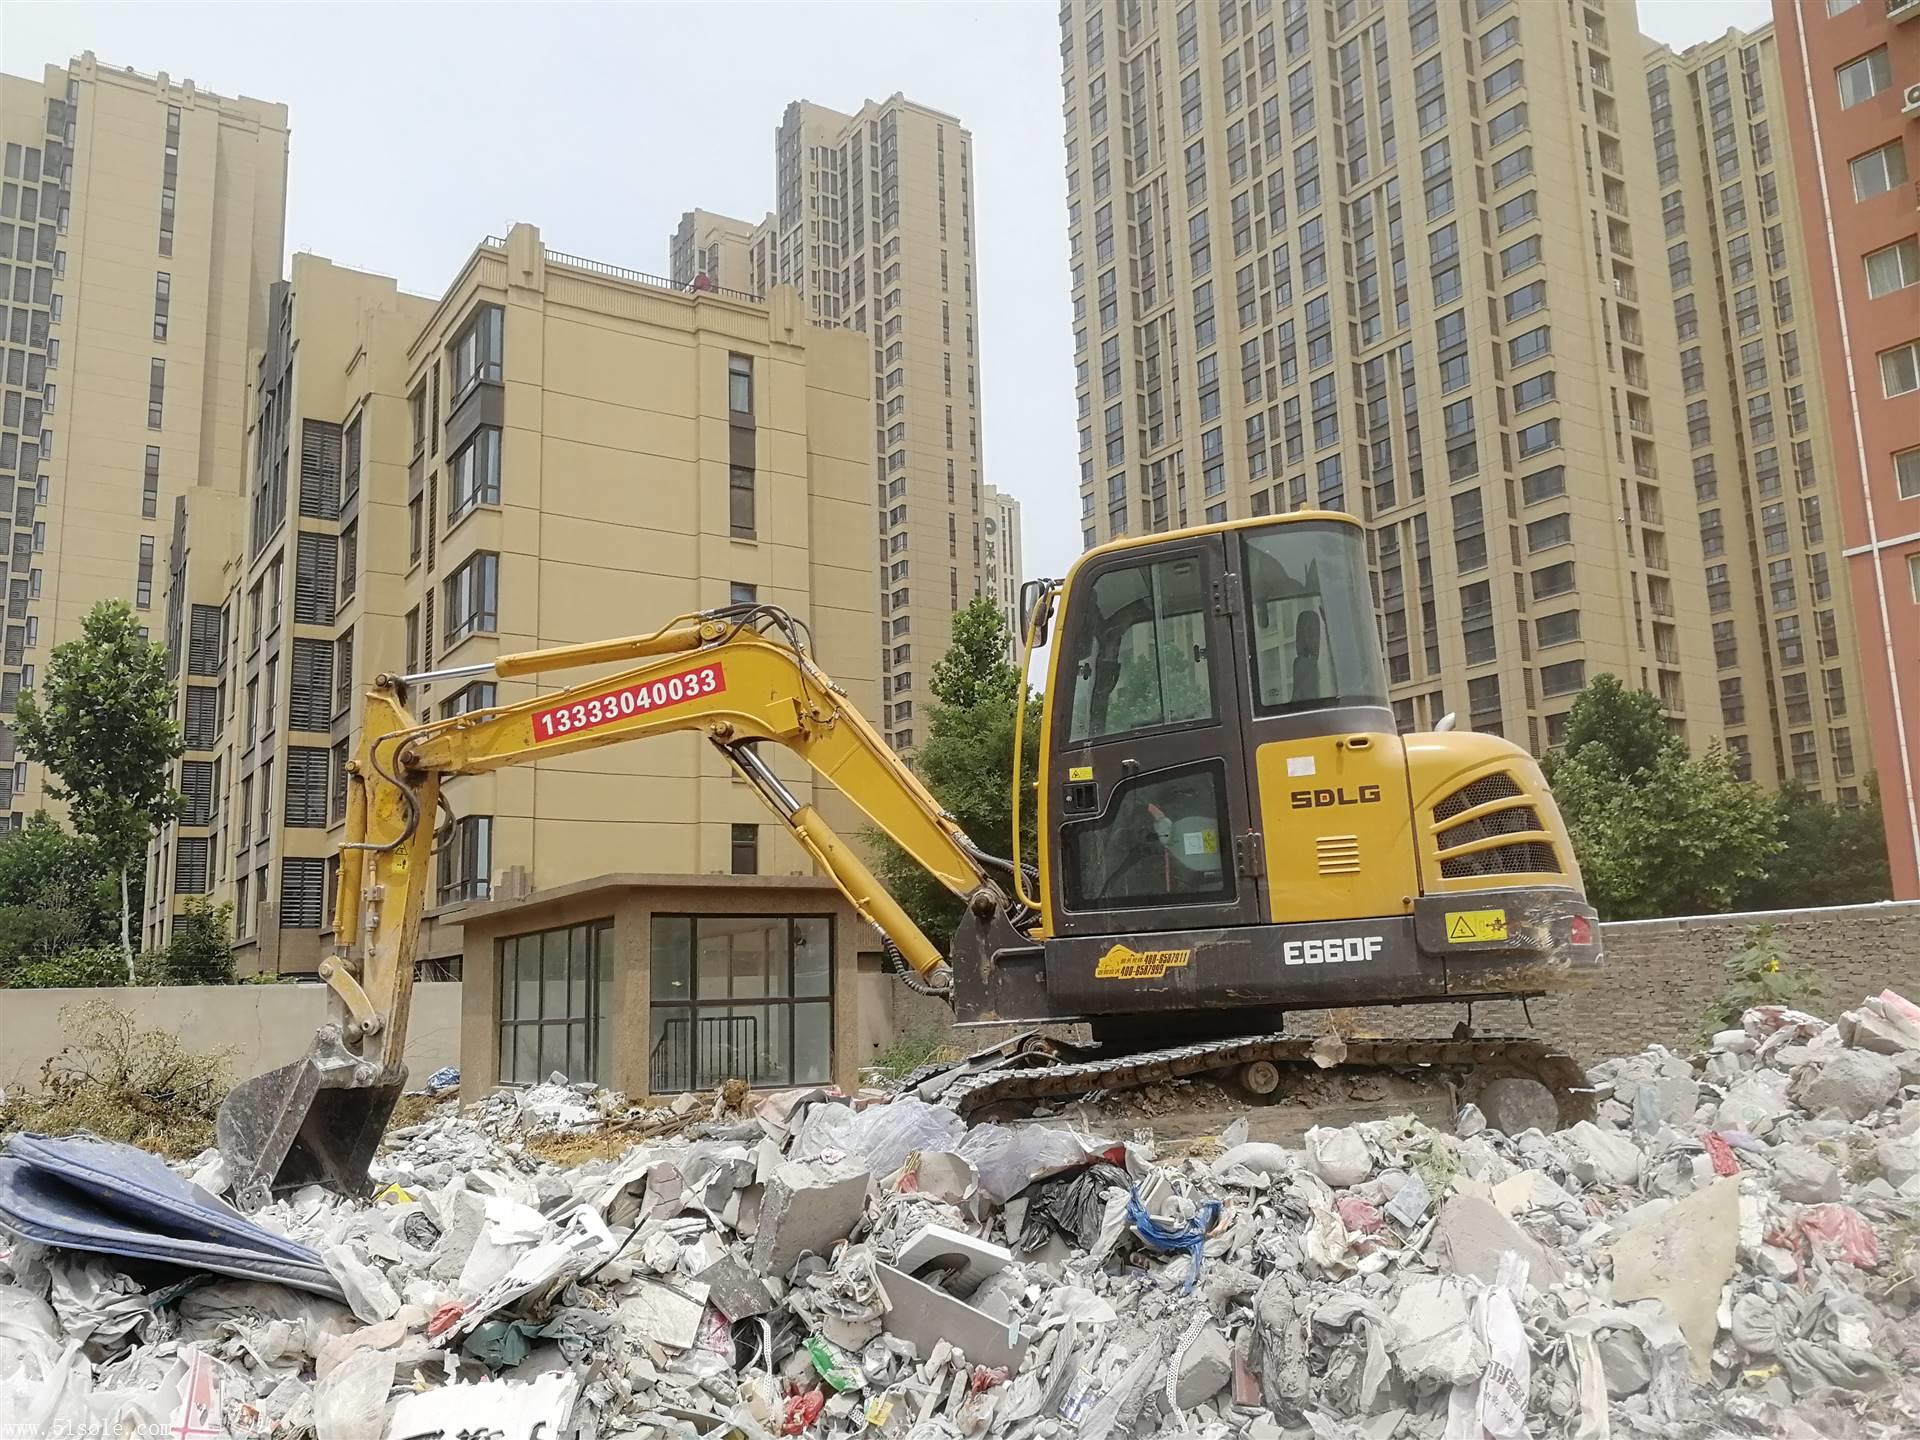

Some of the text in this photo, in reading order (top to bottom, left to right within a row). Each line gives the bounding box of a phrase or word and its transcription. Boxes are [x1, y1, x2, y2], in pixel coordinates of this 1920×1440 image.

[541, 669, 717, 736] 13333040033
[1291, 784, 1382, 810] SDLG
[1284, 936, 1383, 966] E660F
